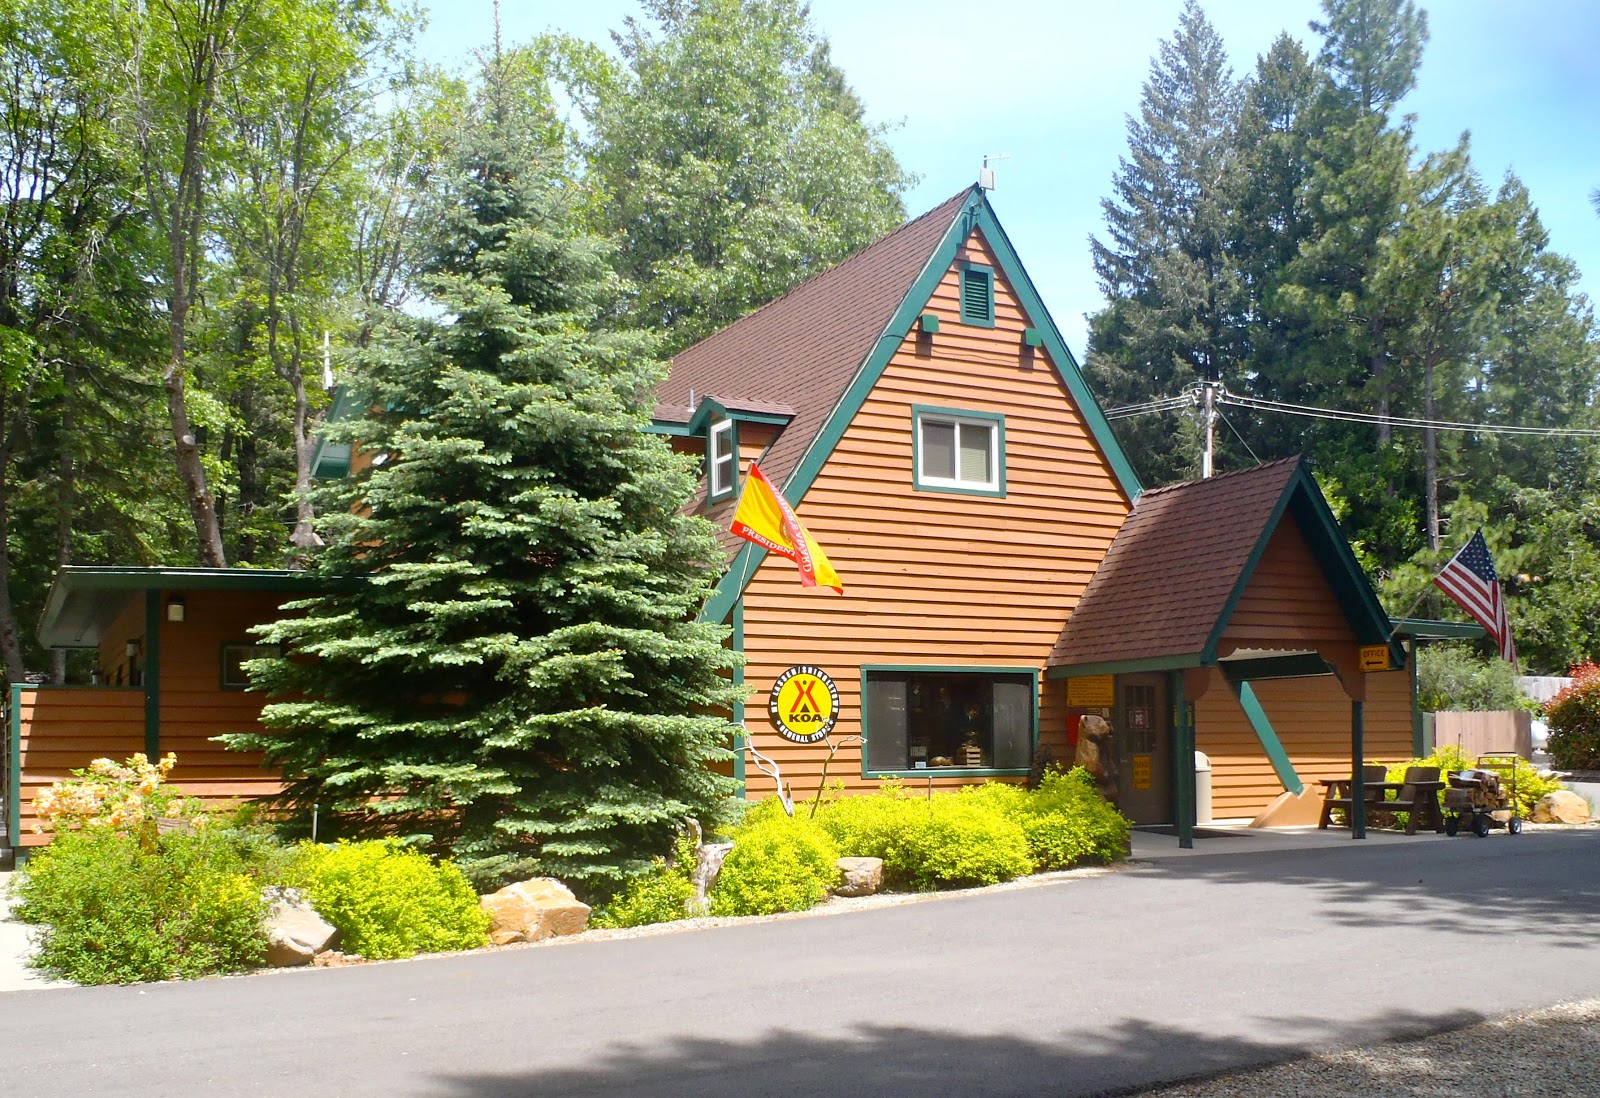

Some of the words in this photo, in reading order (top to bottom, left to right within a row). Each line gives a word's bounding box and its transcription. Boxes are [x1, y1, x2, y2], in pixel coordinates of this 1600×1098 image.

[1362, 649, 1385, 658] OFFICE
[789, 714, 823, 723] KOA
[779, 725, 809, 742] GENERAL
